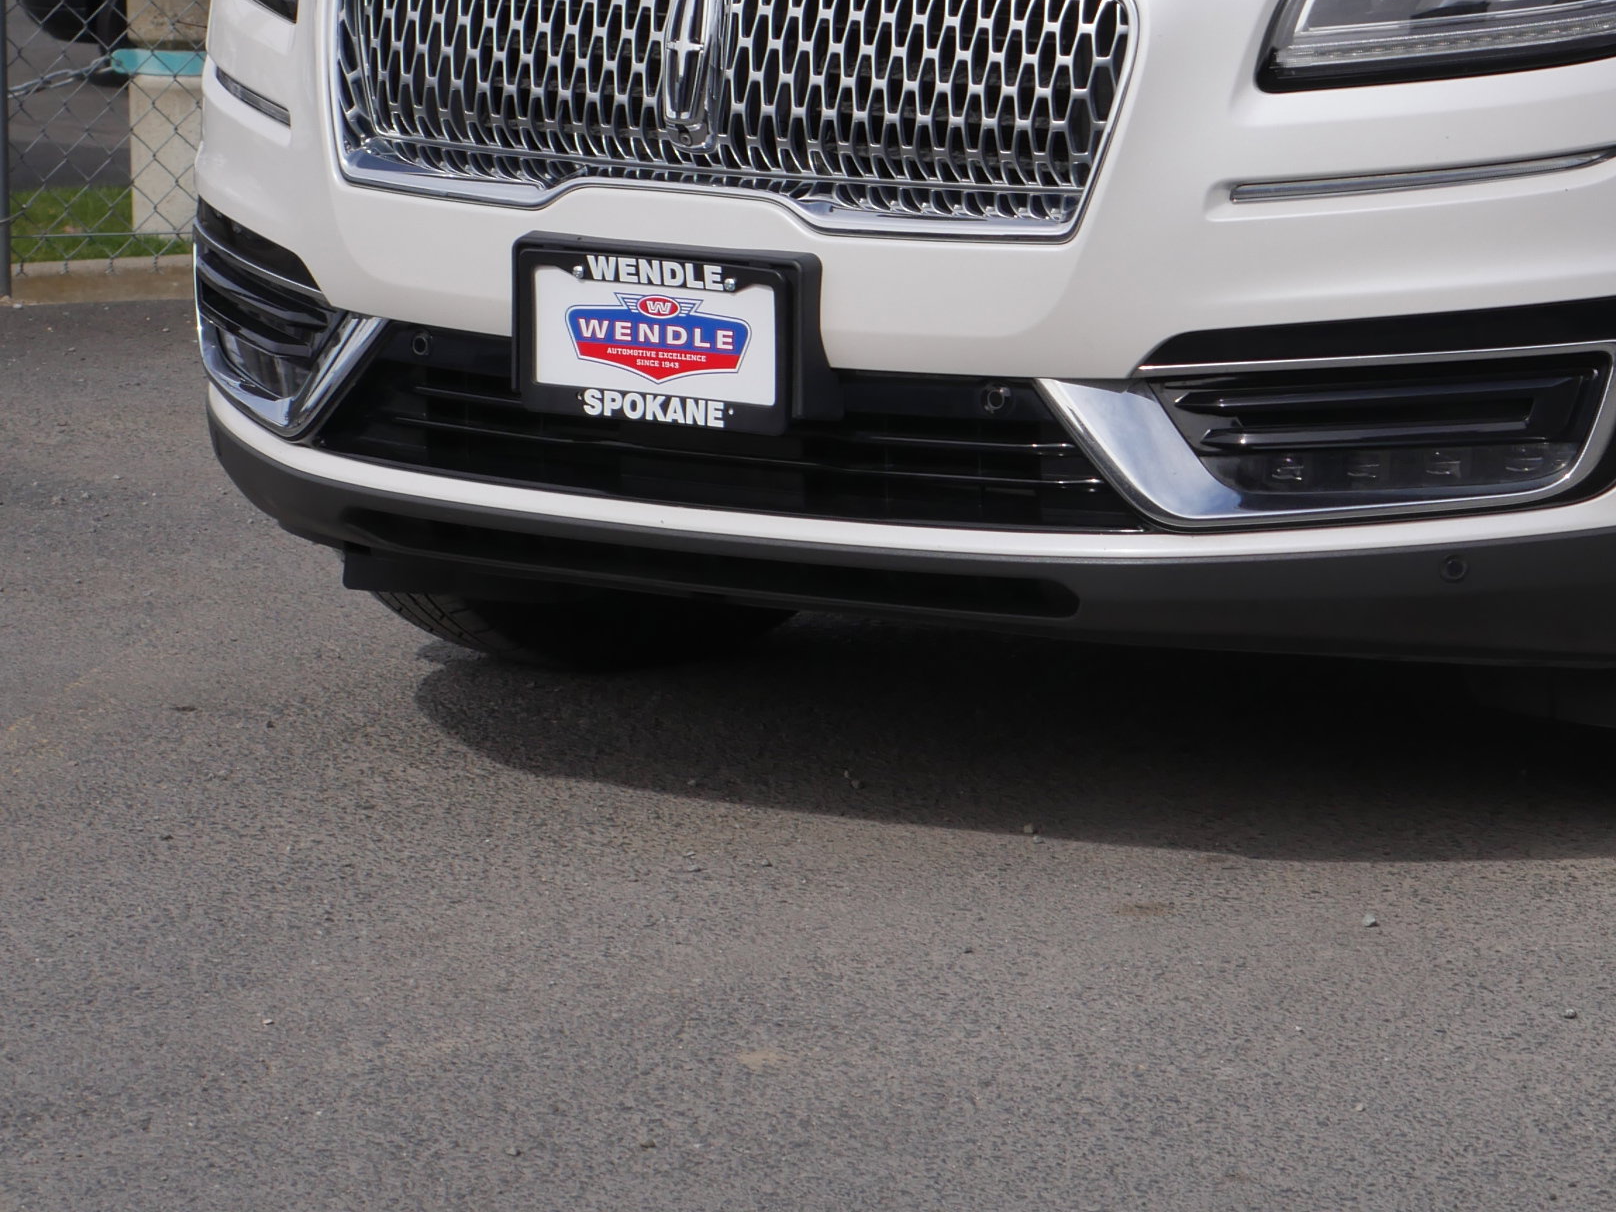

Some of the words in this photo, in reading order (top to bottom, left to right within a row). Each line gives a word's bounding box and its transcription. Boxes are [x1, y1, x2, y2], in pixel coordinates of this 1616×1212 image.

[587, 254, 724, 291] WENDLE
[577, 318, 734, 350] WENDLE
[606, 347, 656, 357] AUTOMOTIVE
[658, 351, 707, 362] EXCELLENCE
[636, 358, 660, 367] SINCE
[661, 361, 679, 369] 1943
[583, 388, 725, 428] SPOKANE
